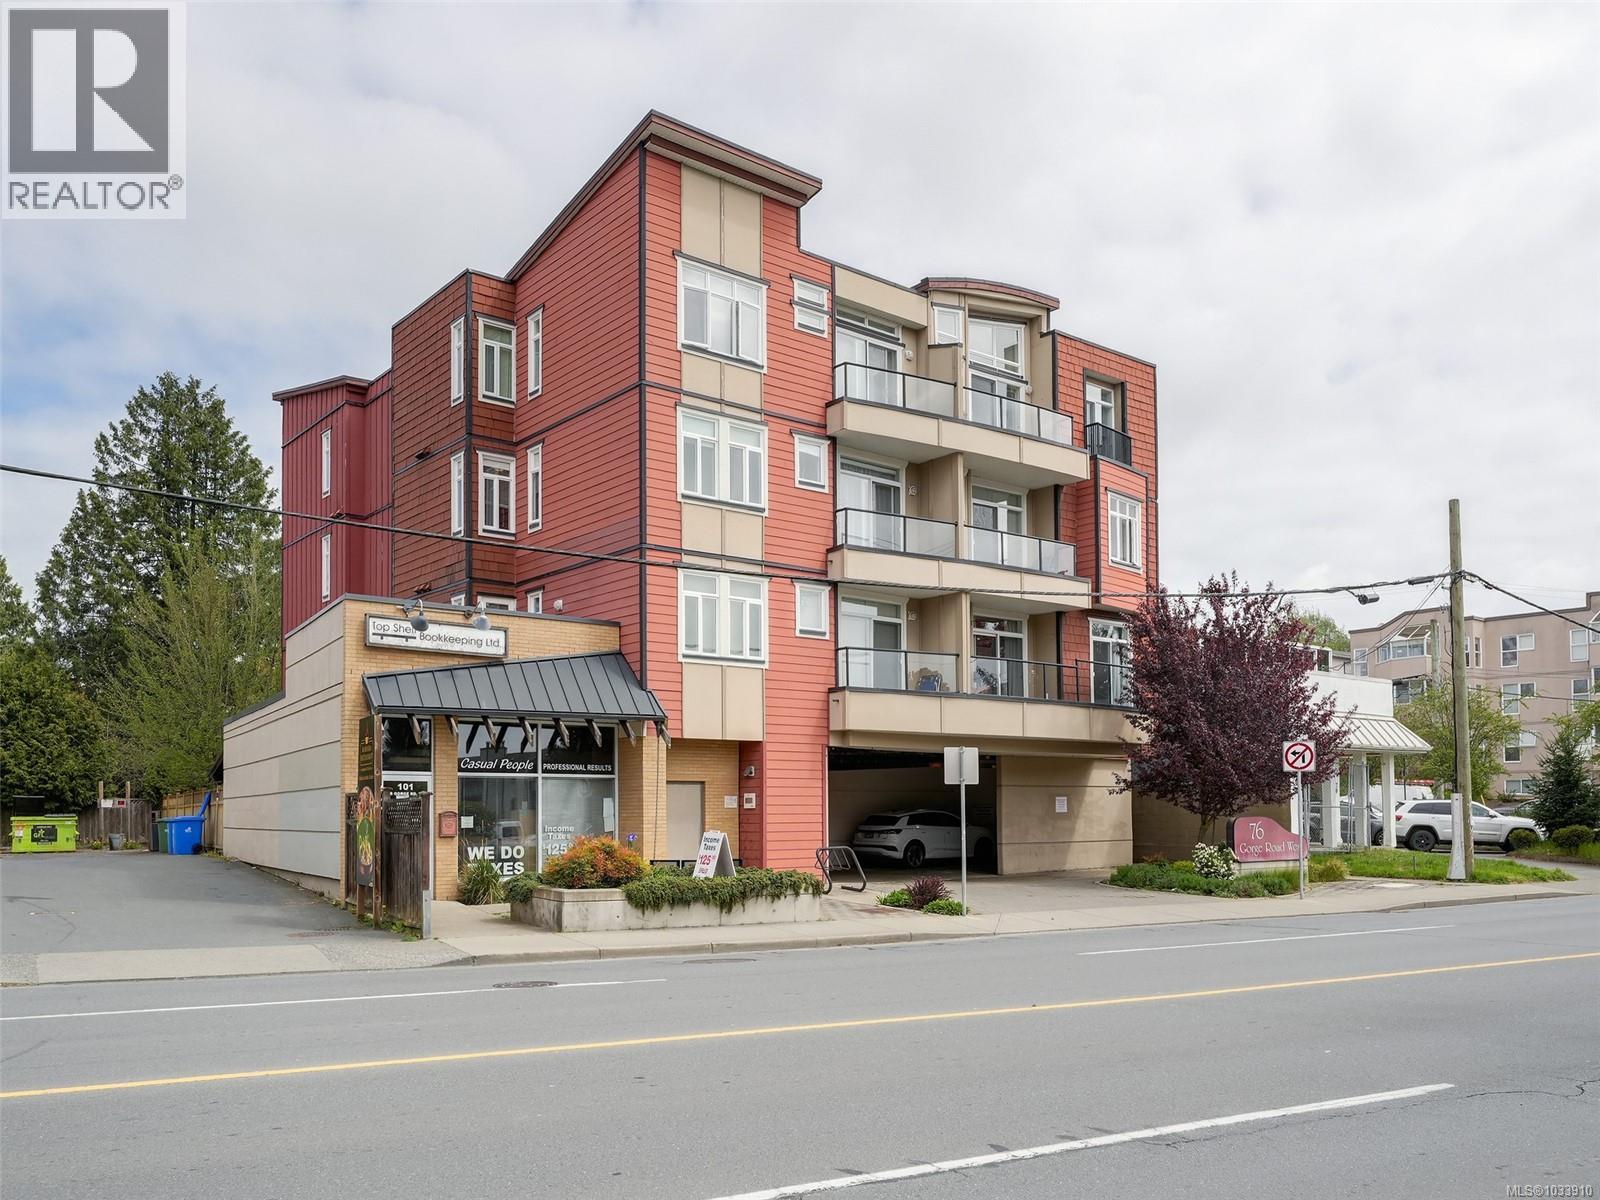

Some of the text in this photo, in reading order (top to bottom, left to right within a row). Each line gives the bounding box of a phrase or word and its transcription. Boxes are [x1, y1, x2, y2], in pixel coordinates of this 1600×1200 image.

[372, 621, 390, 633] Top
[419, 632, 503, 648] Bookkeeping Ltd.
[460, 758, 534, 772] Casual People
[543, 763, 612, 772] PROFESSIONAL RESULTS
[397, 783, 414, 791] 101
[1249, 821, 1265, 840] 76
[467, 845, 525, 860] WE DO
[1239, 842, 1263, 857] Gorge
[1265, 841, 1285, 853] Road
